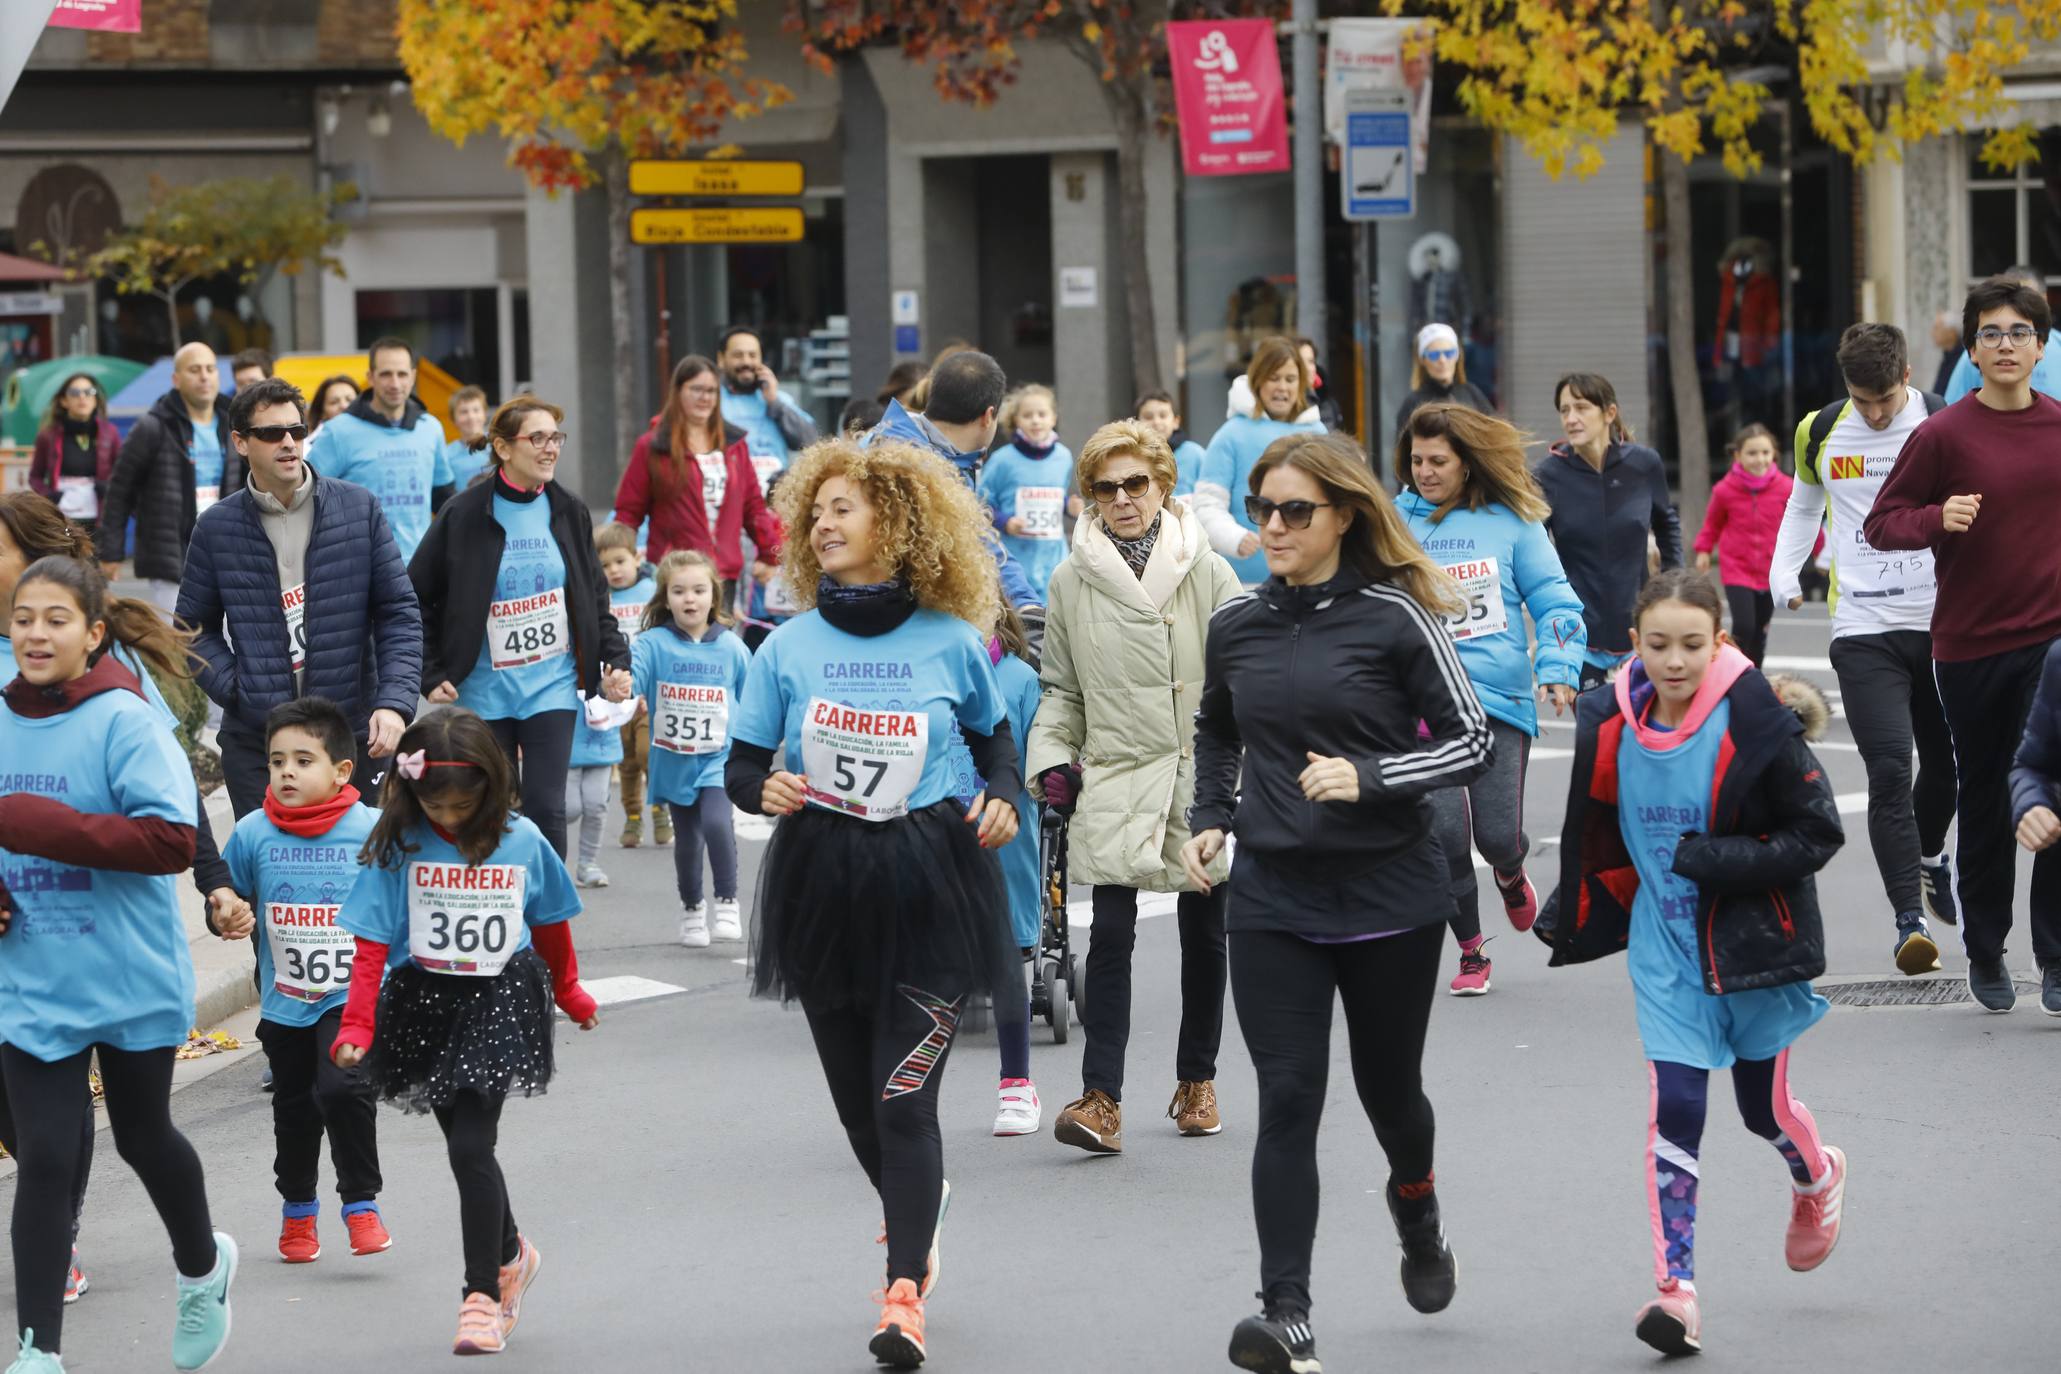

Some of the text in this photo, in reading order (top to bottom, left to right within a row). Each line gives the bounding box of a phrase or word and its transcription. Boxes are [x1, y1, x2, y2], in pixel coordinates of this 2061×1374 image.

[645, 223, 684, 239] Rioja
[1027, 511, 1061, 528] 550
[1876, 555, 1923, 580] 795
[491, 592, 558, 618] CARRERA
[504, 622, 557, 654] 488
[672, 662, 724, 676] CARRERA
[823, 662, 913, 679] CARRERA
[660, 684, 724, 703] CARRERA
[664, 714, 713, 741] 351
[814, 702, 918, 737] CARRERA
[826, 739, 839, 747] VIDA
[840, 742, 875, 754] SALUDABLE
[834, 754, 889, 798] 57
[269, 847, 348, 863] CARRERA
[415, 866, 516, 890] CARRERA
[428, 911, 507, 953] 360
[284, 947, 355, 985] 365
